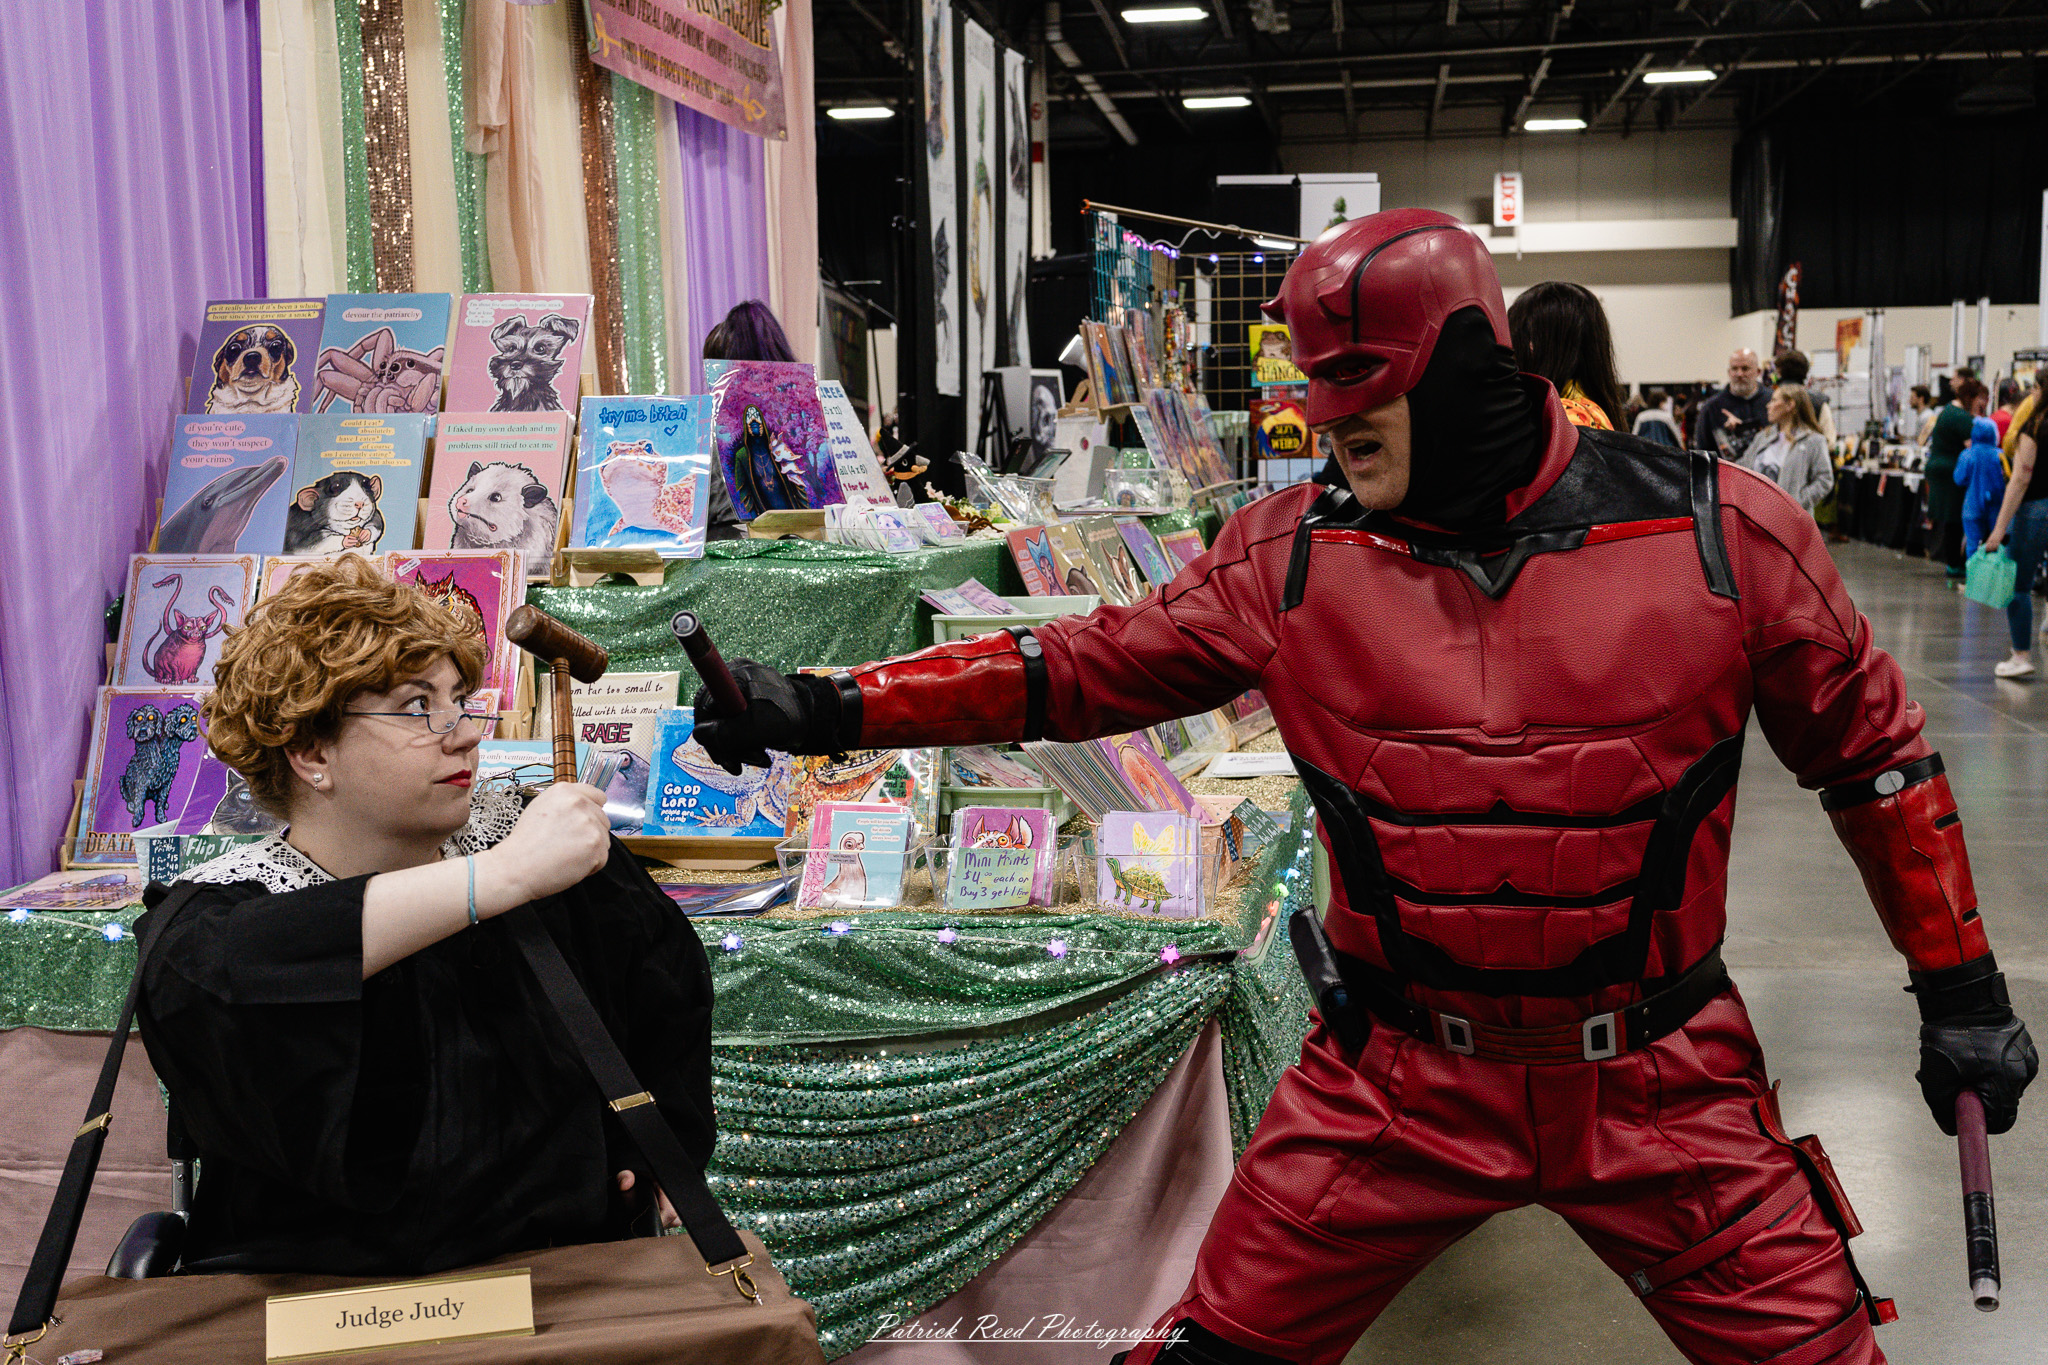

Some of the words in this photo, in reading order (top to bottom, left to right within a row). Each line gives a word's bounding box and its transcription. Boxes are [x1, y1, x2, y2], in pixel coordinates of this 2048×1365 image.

[345, 311, 370, 319] devour
[384, 311, 420, 320] patriarchy
[820, 386, 844, 399] ICES
[599, 406, 624, 429] try
[624, 409, 648, 423] me,
[649, 403, 688, 424] bitch
[188, 423, 196, 432] if
[197, 423, 223, 433] you're
[224, 424, 245, 432] cute,
[453, 425, 473, 433] faked
[507, 425, 528, 433] death
[192, 439, 210, 449] they
[212, 438, 236, 447] won't
[238, 440, 268, 449] suspect
[448, 441, 483, 451] problems
[484, 441, 499, 449] still
[500, 441, 517, 449] tried
[1270, 437, 1301, 450] WEIRD
[185, 456, 205, 465] your
[206, 454, 233, 463] crimes
[848, 482, 858, 491] for
[587, 683, 603, 695] far
[606, 684, 620, 694] too
[624, 680, 652, 694] small
[655, 683, 664, 692] to
[571, 705, 593, 718] illed
[594, 705, 617, 716] with
[620, 704, 638, 715] this
[581, 722, 633, 744] RAGE
[486, 751, 503, 762] only
[504, 752, 538, 763] venturing
[663, 782, 702, 796] GOOD
[882, 781, 898, 789] and
[880, 788, 896, 798] he
[661, 797, 699, 809] LORD
[660, 809, 681, 817] people
[681, 810, 695, 819] are
[664, 815, 687, 823] dumb
[186, 837, 216, 861] Flip
[167, 853, 179, 862] $15
[964, 852, 992, 869] Mini
[996, 850, 1031, 868] Prints
[166, 862, 179, 871] $40
[185, 858, 202, 870] thi
[993, 871, 1016, 884] each
[1018, 876, 1030, 884] or
[960, 886, 979, 901] Buy
[980, 886, 988, 897] 3
[991, 886, 1010, 900] get
[336, 1306, 402, 1329] Judge
[409, 1297, 464, 1320] Judy
